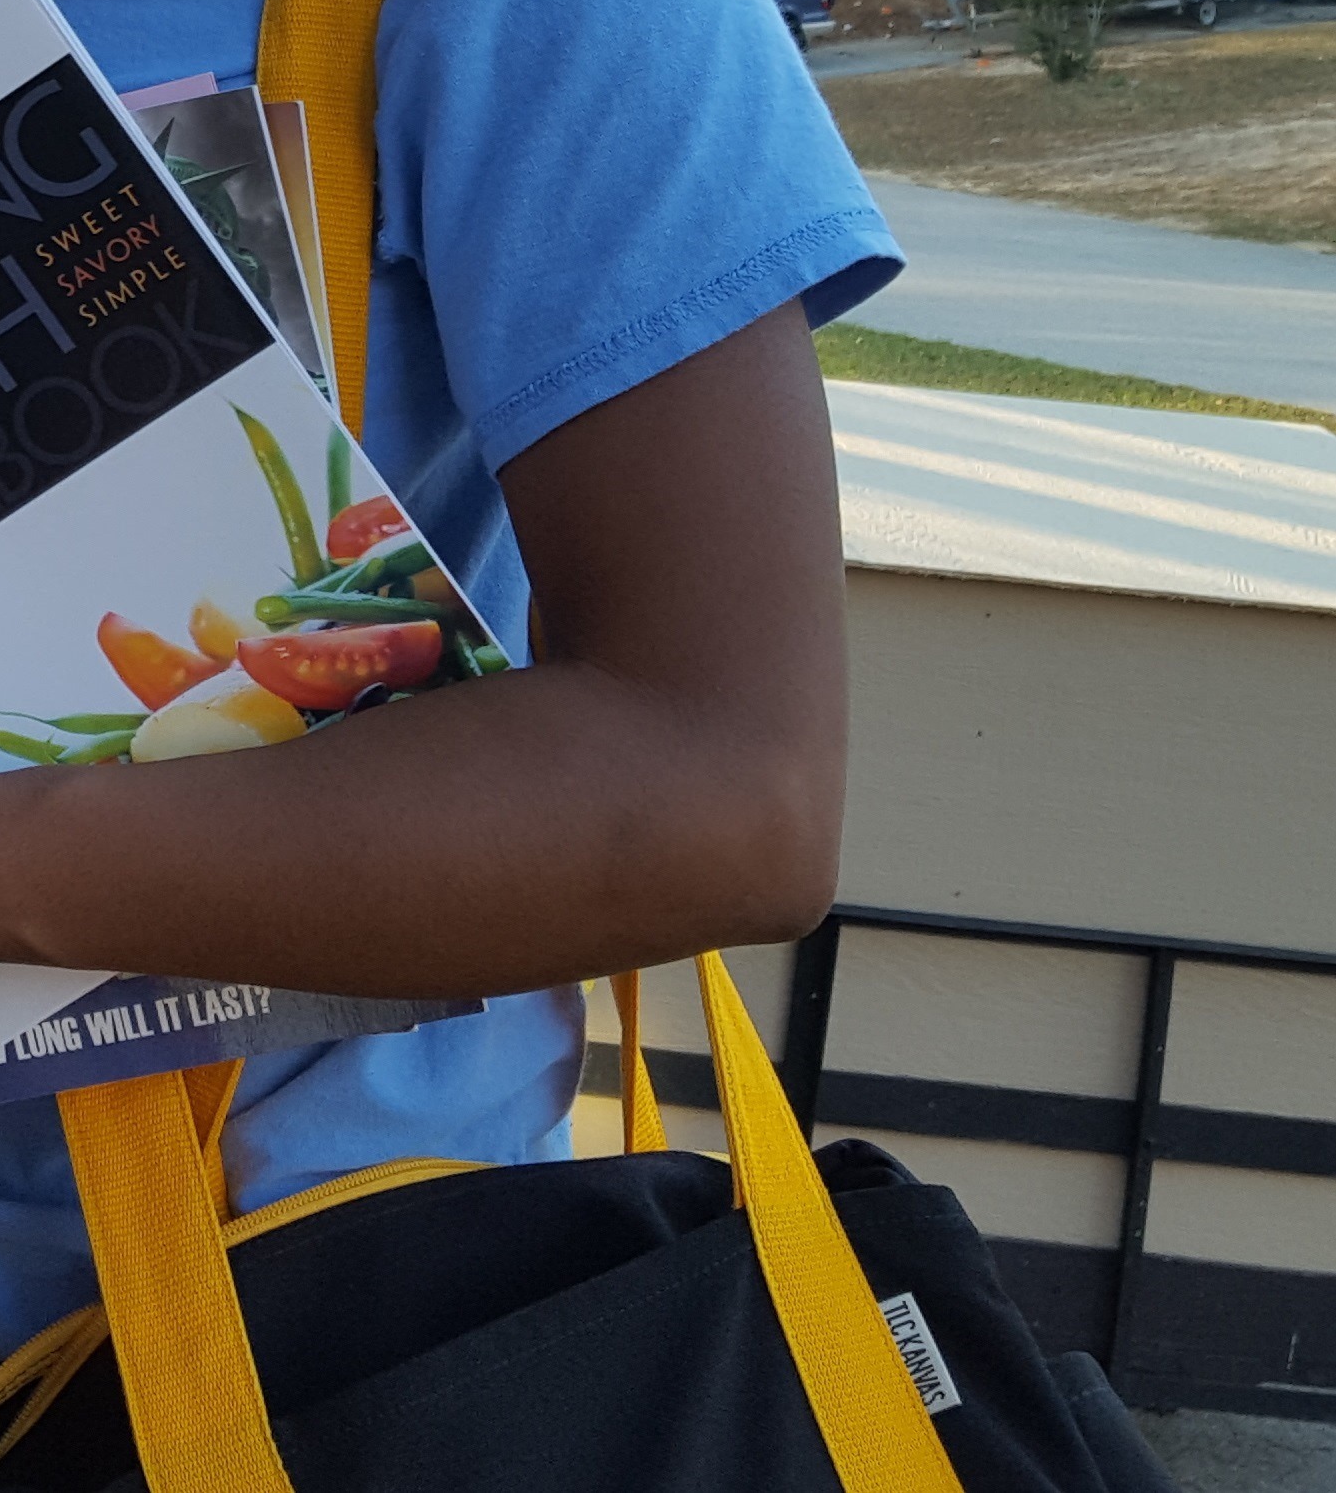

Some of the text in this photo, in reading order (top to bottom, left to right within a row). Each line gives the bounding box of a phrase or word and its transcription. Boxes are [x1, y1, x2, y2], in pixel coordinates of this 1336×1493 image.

[34, 183, 141, 267] SWEET
[56, 213, 161, 297] SAVORY
[78, 245, 187, 328] SIMPLE
[13, 1016, 83, 1061] LONG
[84, 1003, 155, 1047] WILL
[154, 995, 183, 1034] IT
[185, 983, 272, 1028] LAST?
